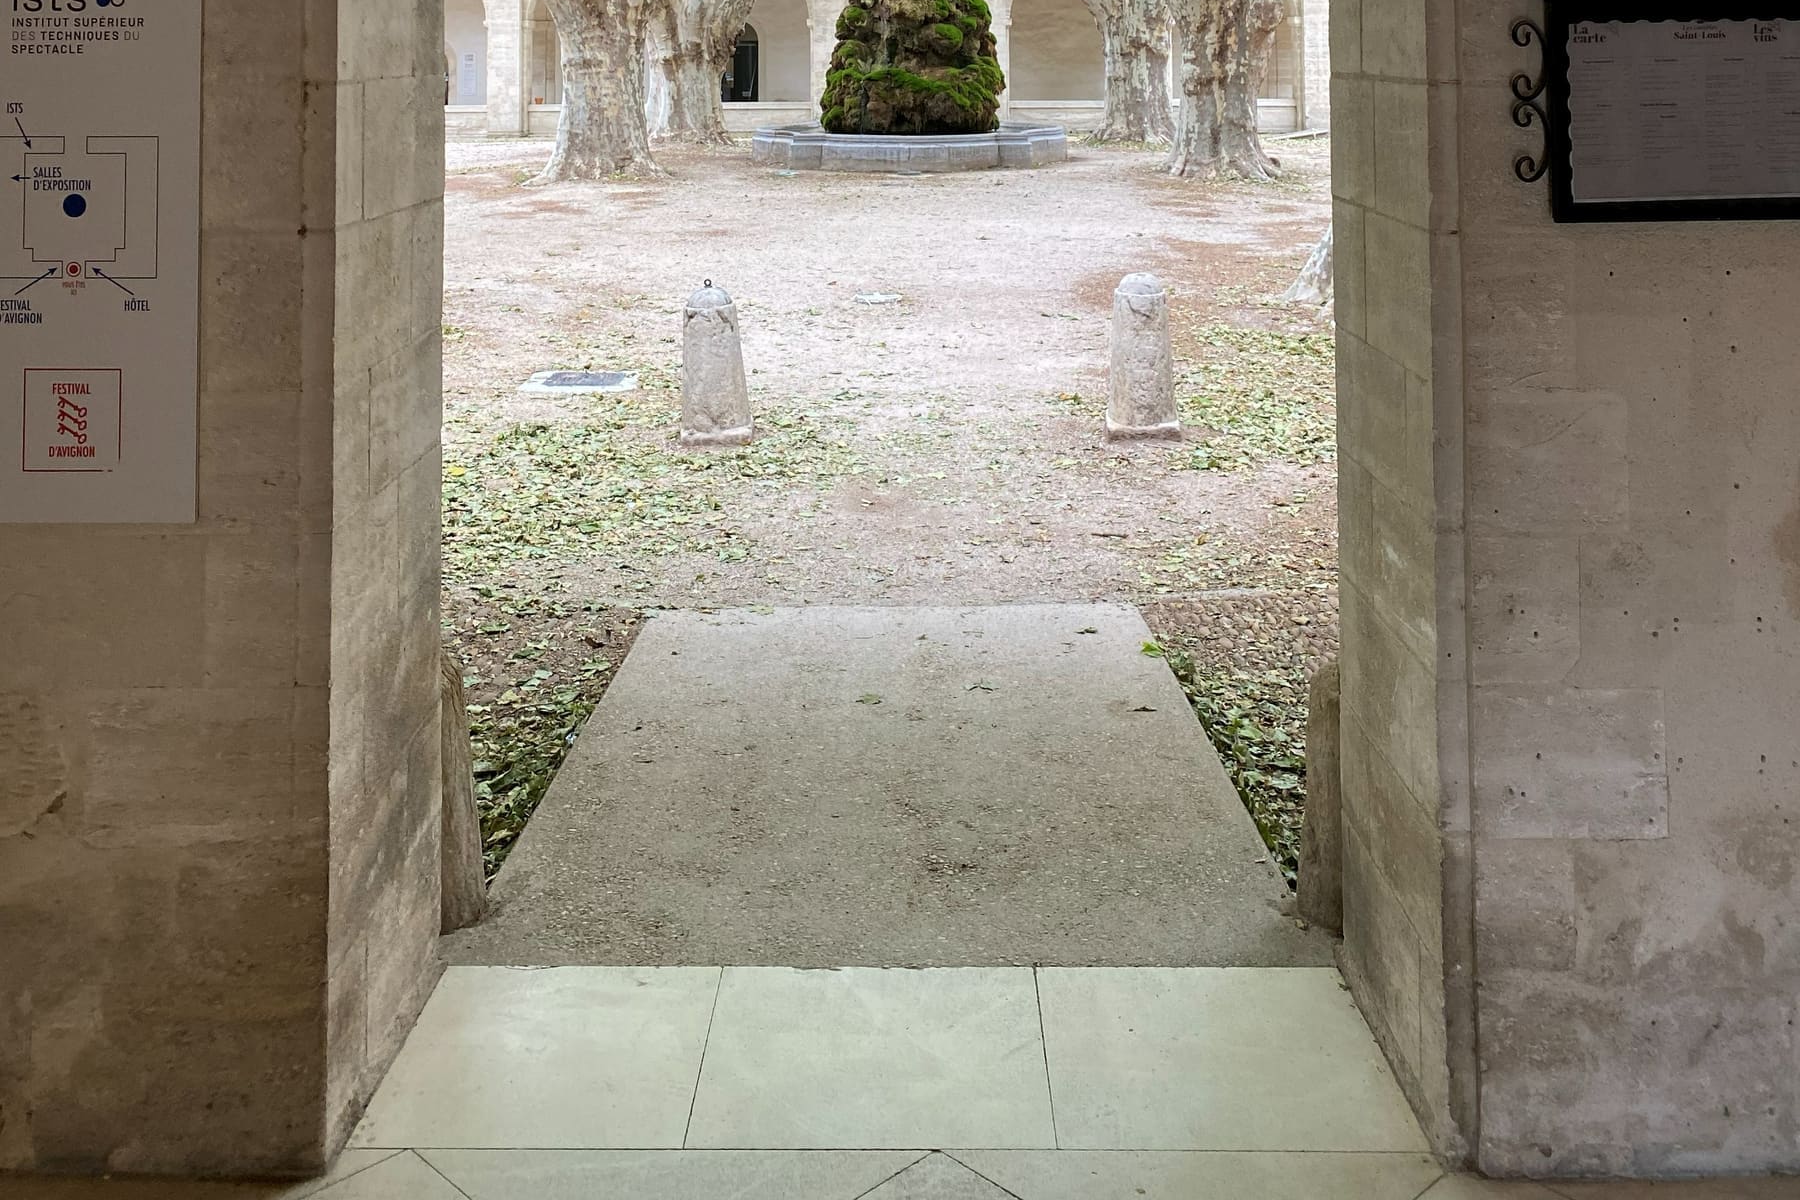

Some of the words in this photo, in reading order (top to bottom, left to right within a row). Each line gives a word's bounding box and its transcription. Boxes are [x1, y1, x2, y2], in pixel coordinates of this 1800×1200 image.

[11, 17, 70, 28] INSTITUT
[73, 15, 145, 28] SUPÉRIEUR
[11, 30, 36, 41] DES
[40, 30, 120, 42] TECHNIQUES
[123, 30, 140, 41] DU
[1573, 33, 1607, 43] carte
[11, 44, 84, 55] SPECTACLE
[6, 102, 24, 114] ISTS
[33, 166, 62, 178] SALLES
[33, 179, 92, 191] D'EXPOSITION
[0, 299, 32, 312] ESTIVAL
[124, 298, 150, 312] HÔTEL
[52, 383, 91, 395] FESTIVAL
[48, 446, 96, 458] D'AVIGNON
